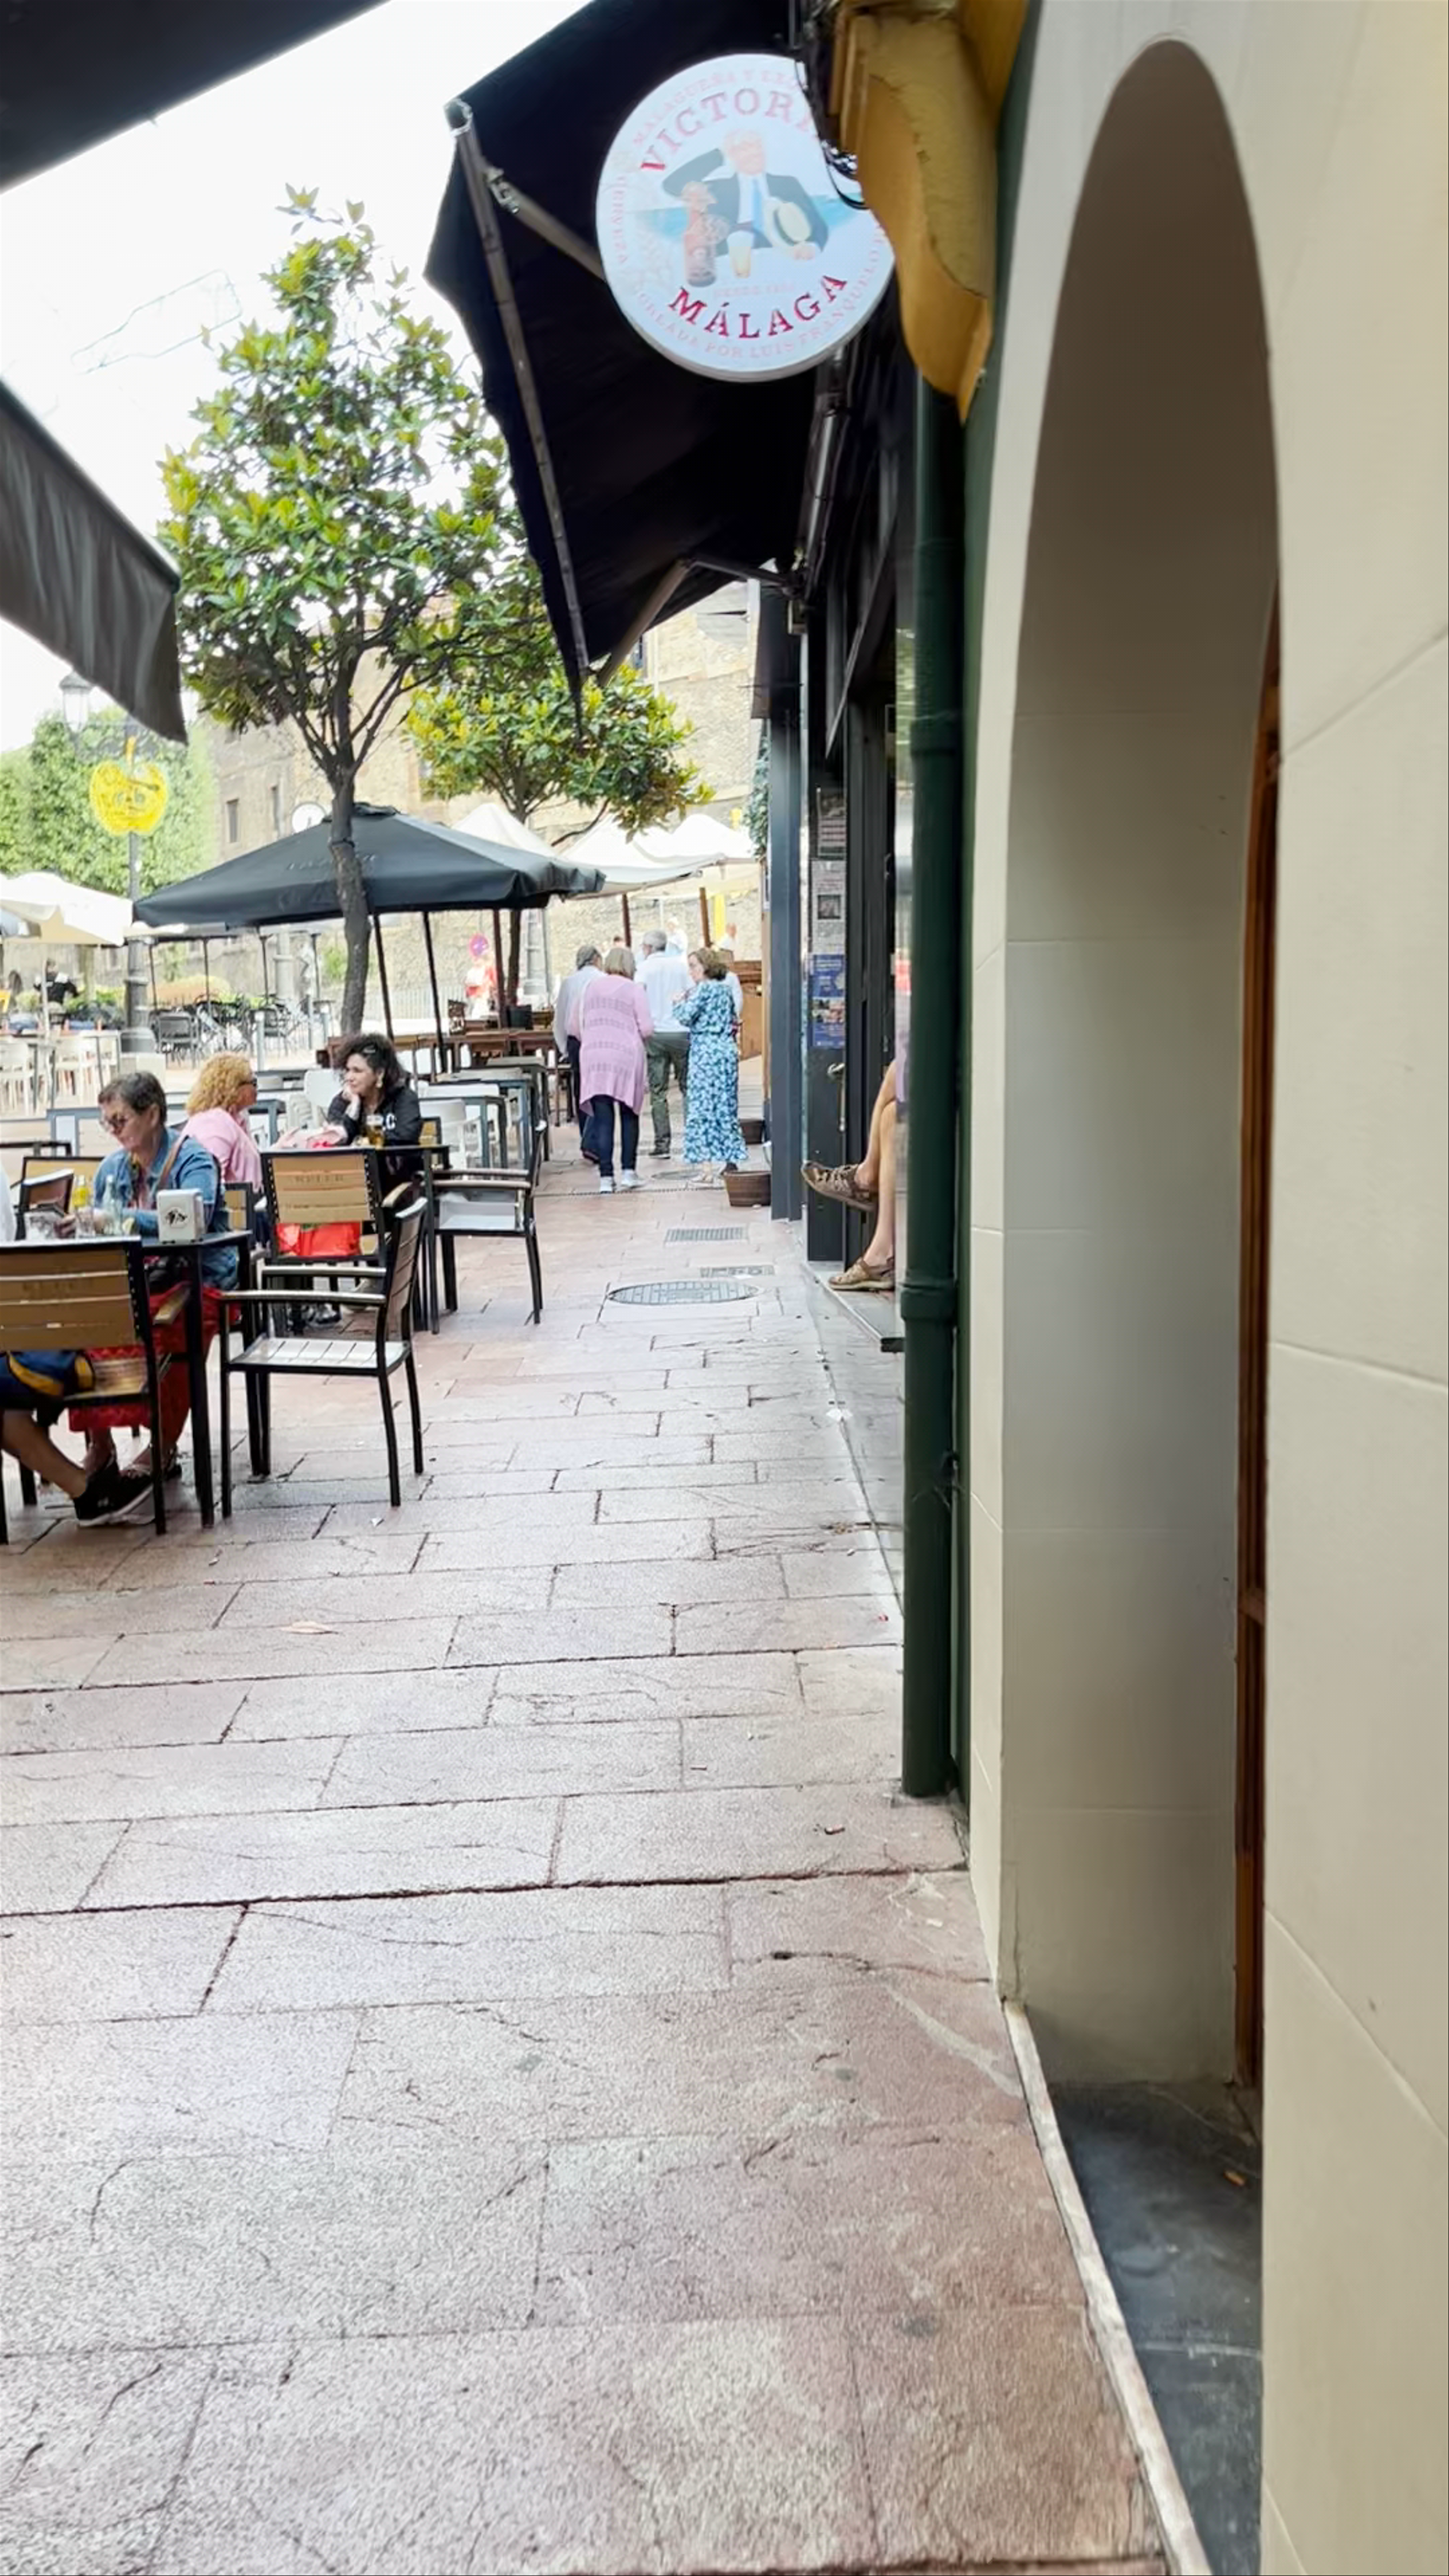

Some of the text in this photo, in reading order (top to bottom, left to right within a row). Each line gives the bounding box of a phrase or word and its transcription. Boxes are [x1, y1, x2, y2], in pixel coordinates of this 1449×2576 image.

[668, 274, 848, 339] MÁLAGA
[703, 342, 743, 358] POR
[749, 340, 795, 359] LUIS
